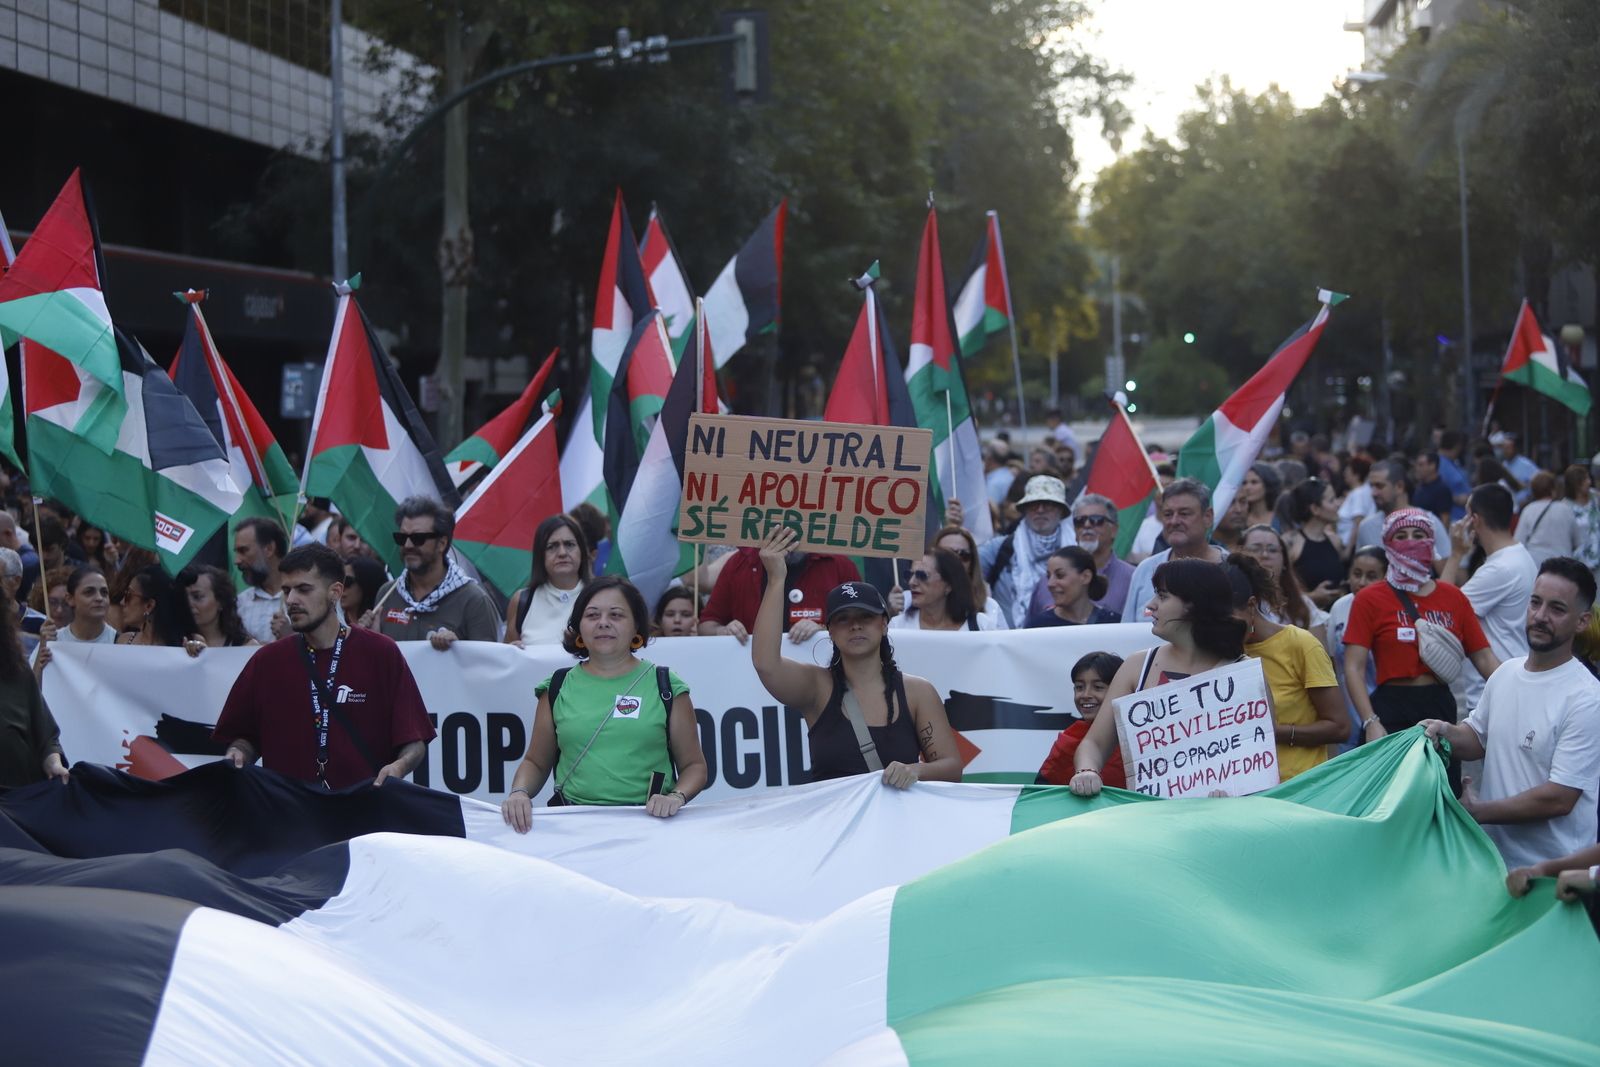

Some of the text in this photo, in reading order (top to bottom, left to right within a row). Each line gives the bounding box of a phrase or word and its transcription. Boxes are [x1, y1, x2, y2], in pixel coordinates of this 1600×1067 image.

[691, 424, 921, 471] NI NEUTRAL
[686, 467, 921, 516] NI APOLÍTICO
[682, 495, 902, 551] SÉ REBELDE
[334, 638, 343, 655] PRIDE
[312, 695, 320, 713] PRIDE
[1128, 676, 1235, 727] QUE TU
[1136, 699, 1268, 754] PRIVILEGIO
[1137, 725, 1265, 783] NO OPAQUE A
[1167, 750, 1274, 797] HUMANIDAD
